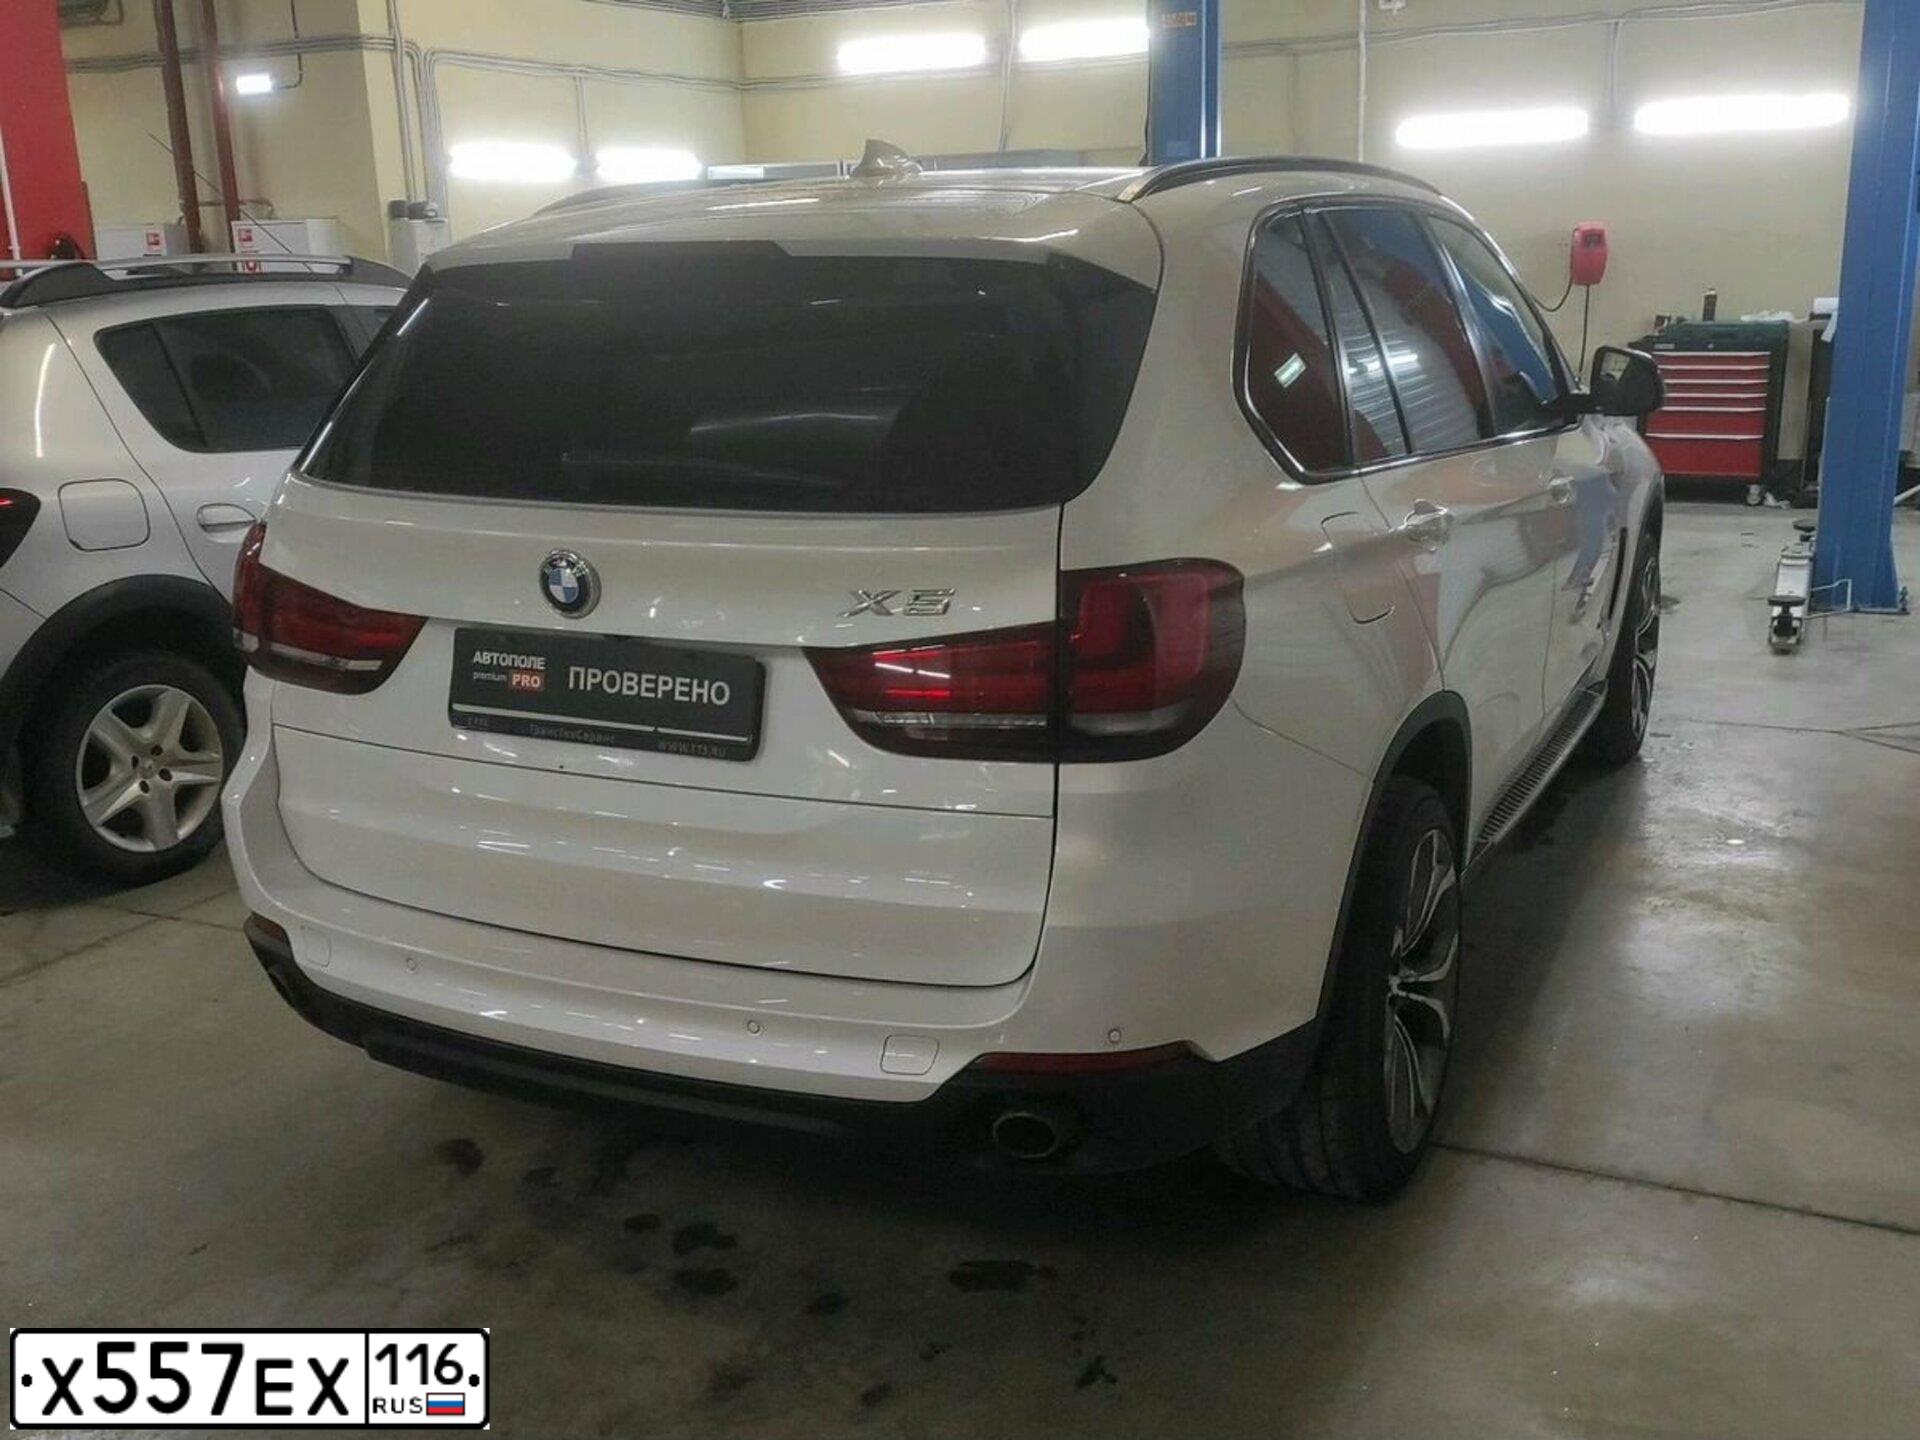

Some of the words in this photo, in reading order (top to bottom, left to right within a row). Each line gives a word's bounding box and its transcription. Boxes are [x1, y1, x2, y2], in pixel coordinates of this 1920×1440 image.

[837, 588, 956, 617] X5
[473, 651, 547, 670] АВТОПОЛЕ
[473, 672, 507, 682] premium
[512, 673, 541, 688] PRO
[568, 666, 731, 706] ПРОВЕРЕНО
